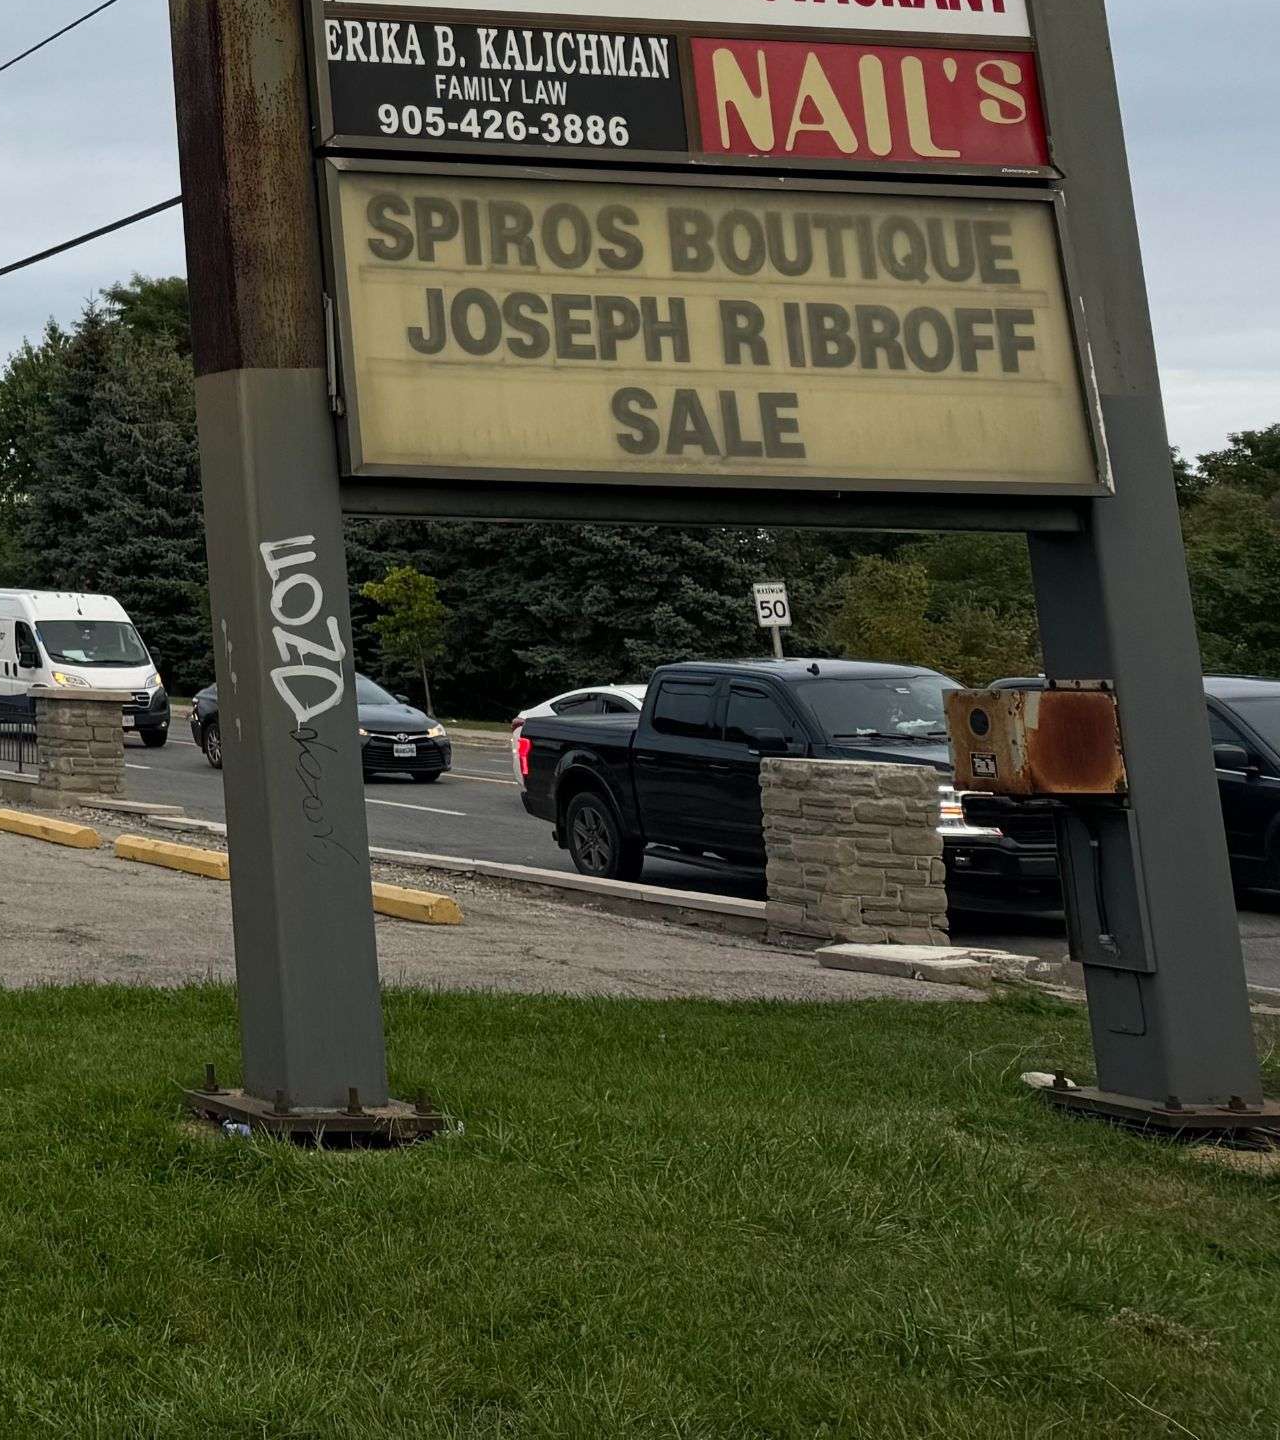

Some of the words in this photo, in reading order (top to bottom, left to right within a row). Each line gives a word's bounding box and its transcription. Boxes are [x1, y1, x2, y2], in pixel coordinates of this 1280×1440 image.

[324, 19, 426, 65] ERIKA
[434, 26, 466, 69] B.
[477, 28, 670, 79] KALICHMAN
[435, 74, 513, 103] FAMILY
[521, 79, 567, 106] LAW
[712, 48, 1026, 158] NAIL'S
[377, 103, 630, 147] 905-426-3886
[365, 194, 644, 273] SPIROS
[667, 205, 1021, 286] BOUTIQUE
[408, 287, 691, 363] JOSEPH
[610, 386, 806, 459] SALE
[760, 600, 786, 619] 50
